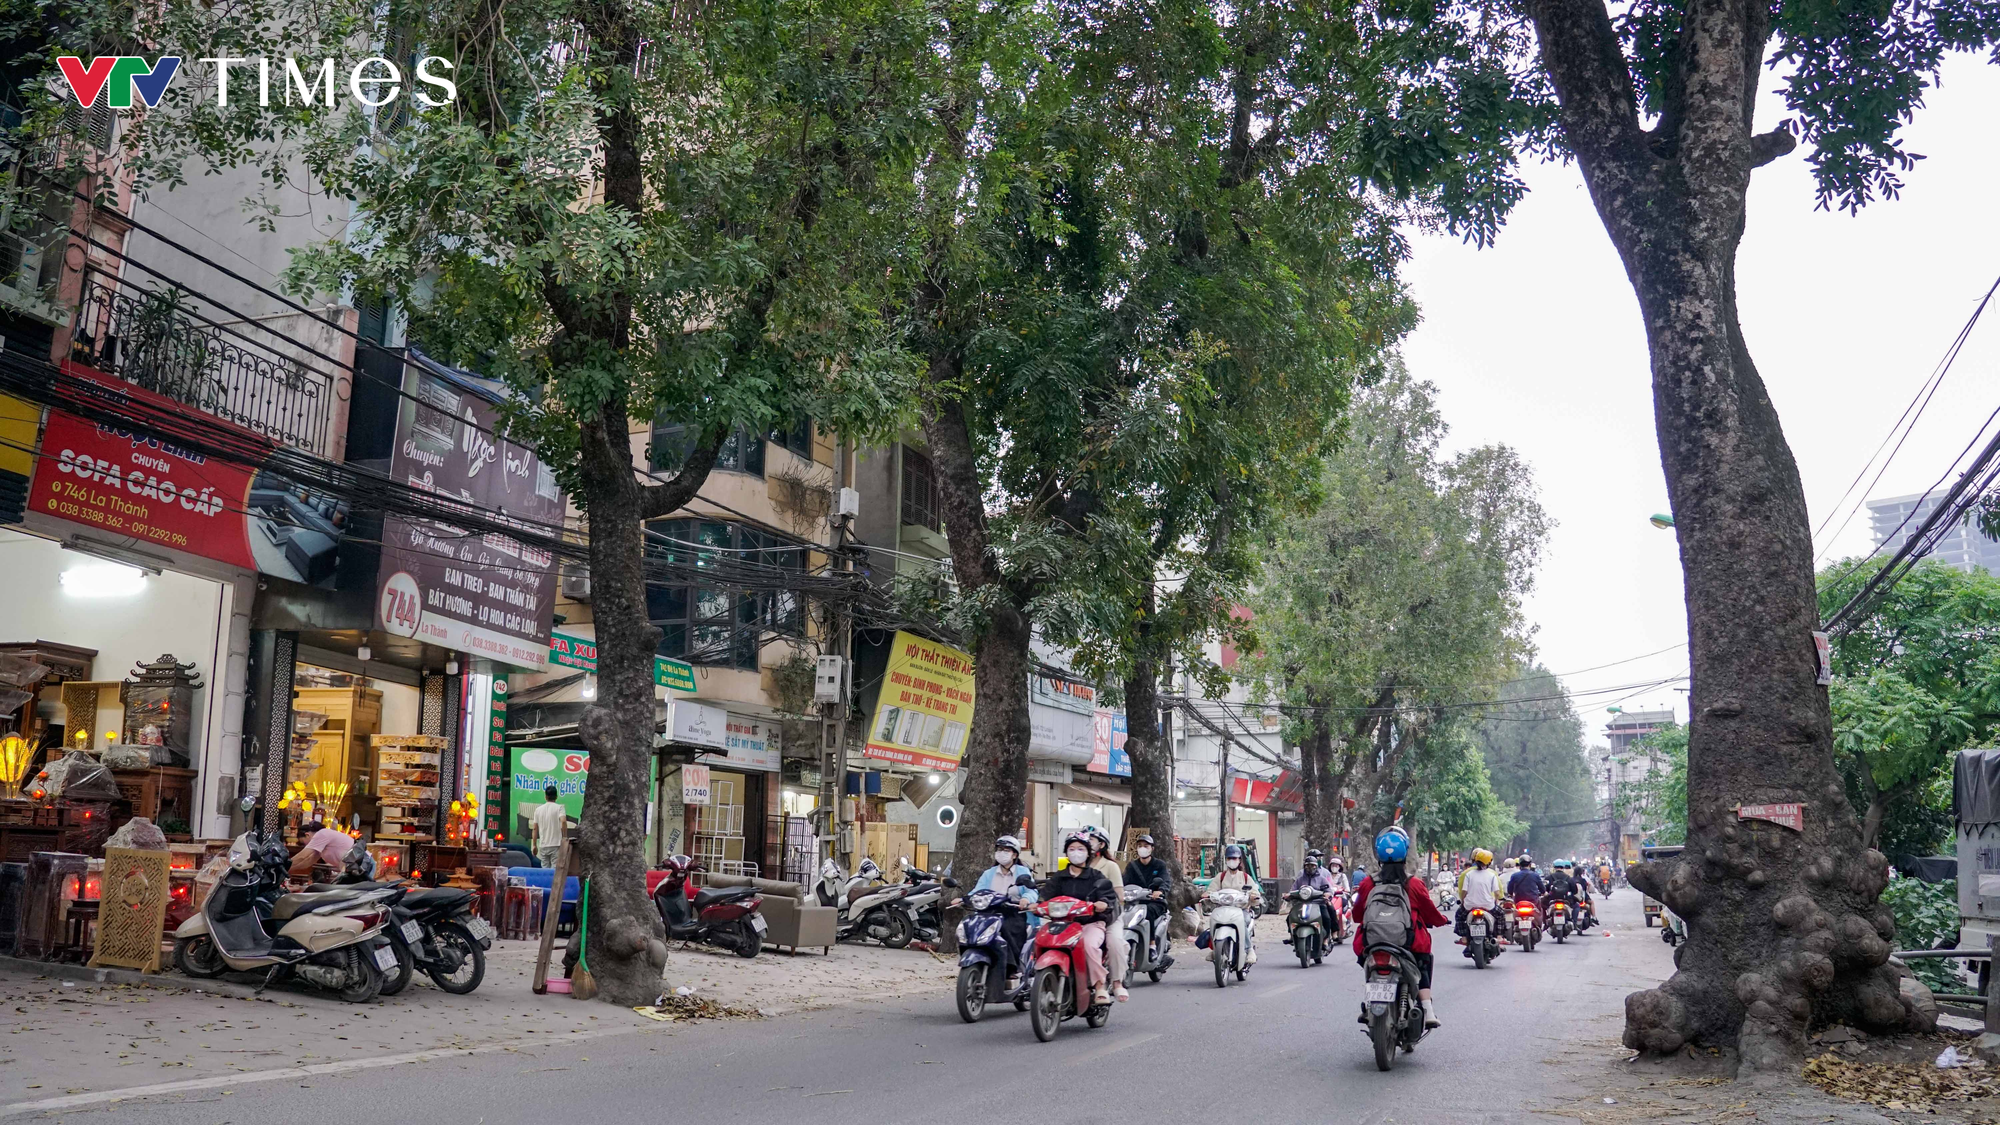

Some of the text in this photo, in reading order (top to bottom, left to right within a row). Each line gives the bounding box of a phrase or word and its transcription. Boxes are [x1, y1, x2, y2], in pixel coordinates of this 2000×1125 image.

[131, 452, 170, 474] CHUYÊN
[57, 449, 224, 517] SOFA CAO CẤP
[64, 482, 149, 519] 746 La Thành
[59, 501, 78, 516] 038
[80, 507, 104, 523] 3388
[106, 513, 122, 528] 362
[132, 521, 148, 535] 091
[149, 526, 170, 542] 2292
[172, 533, 188, 546] 996
[463, 573, 483, 594] TREO
[386, 587, 447, 640] 744 La Thành
[428, 585, 445, 608] BÁT
[478, 605, 489, 625] LỌ
[490, 610, 505, 627] HOA
[505, 612, 520, 631] CÁC
[920, 648, 940, 665] THẤT
[495, 682, 506, 692] 742
[493, 717, 504, 727] So
[493, 732, 502, 742] Fa
[490, 745, 504, 757] Bàn
[489, 776, 501, 788] Kệ
[515, 773, 540, 793] Nhận
[559, 775, 579, 797] ghế
[685, 788, 707, 797] 2/740
[487, 805, 500, 815] Bàn
[1741, 806, 1766, 816] MUA
